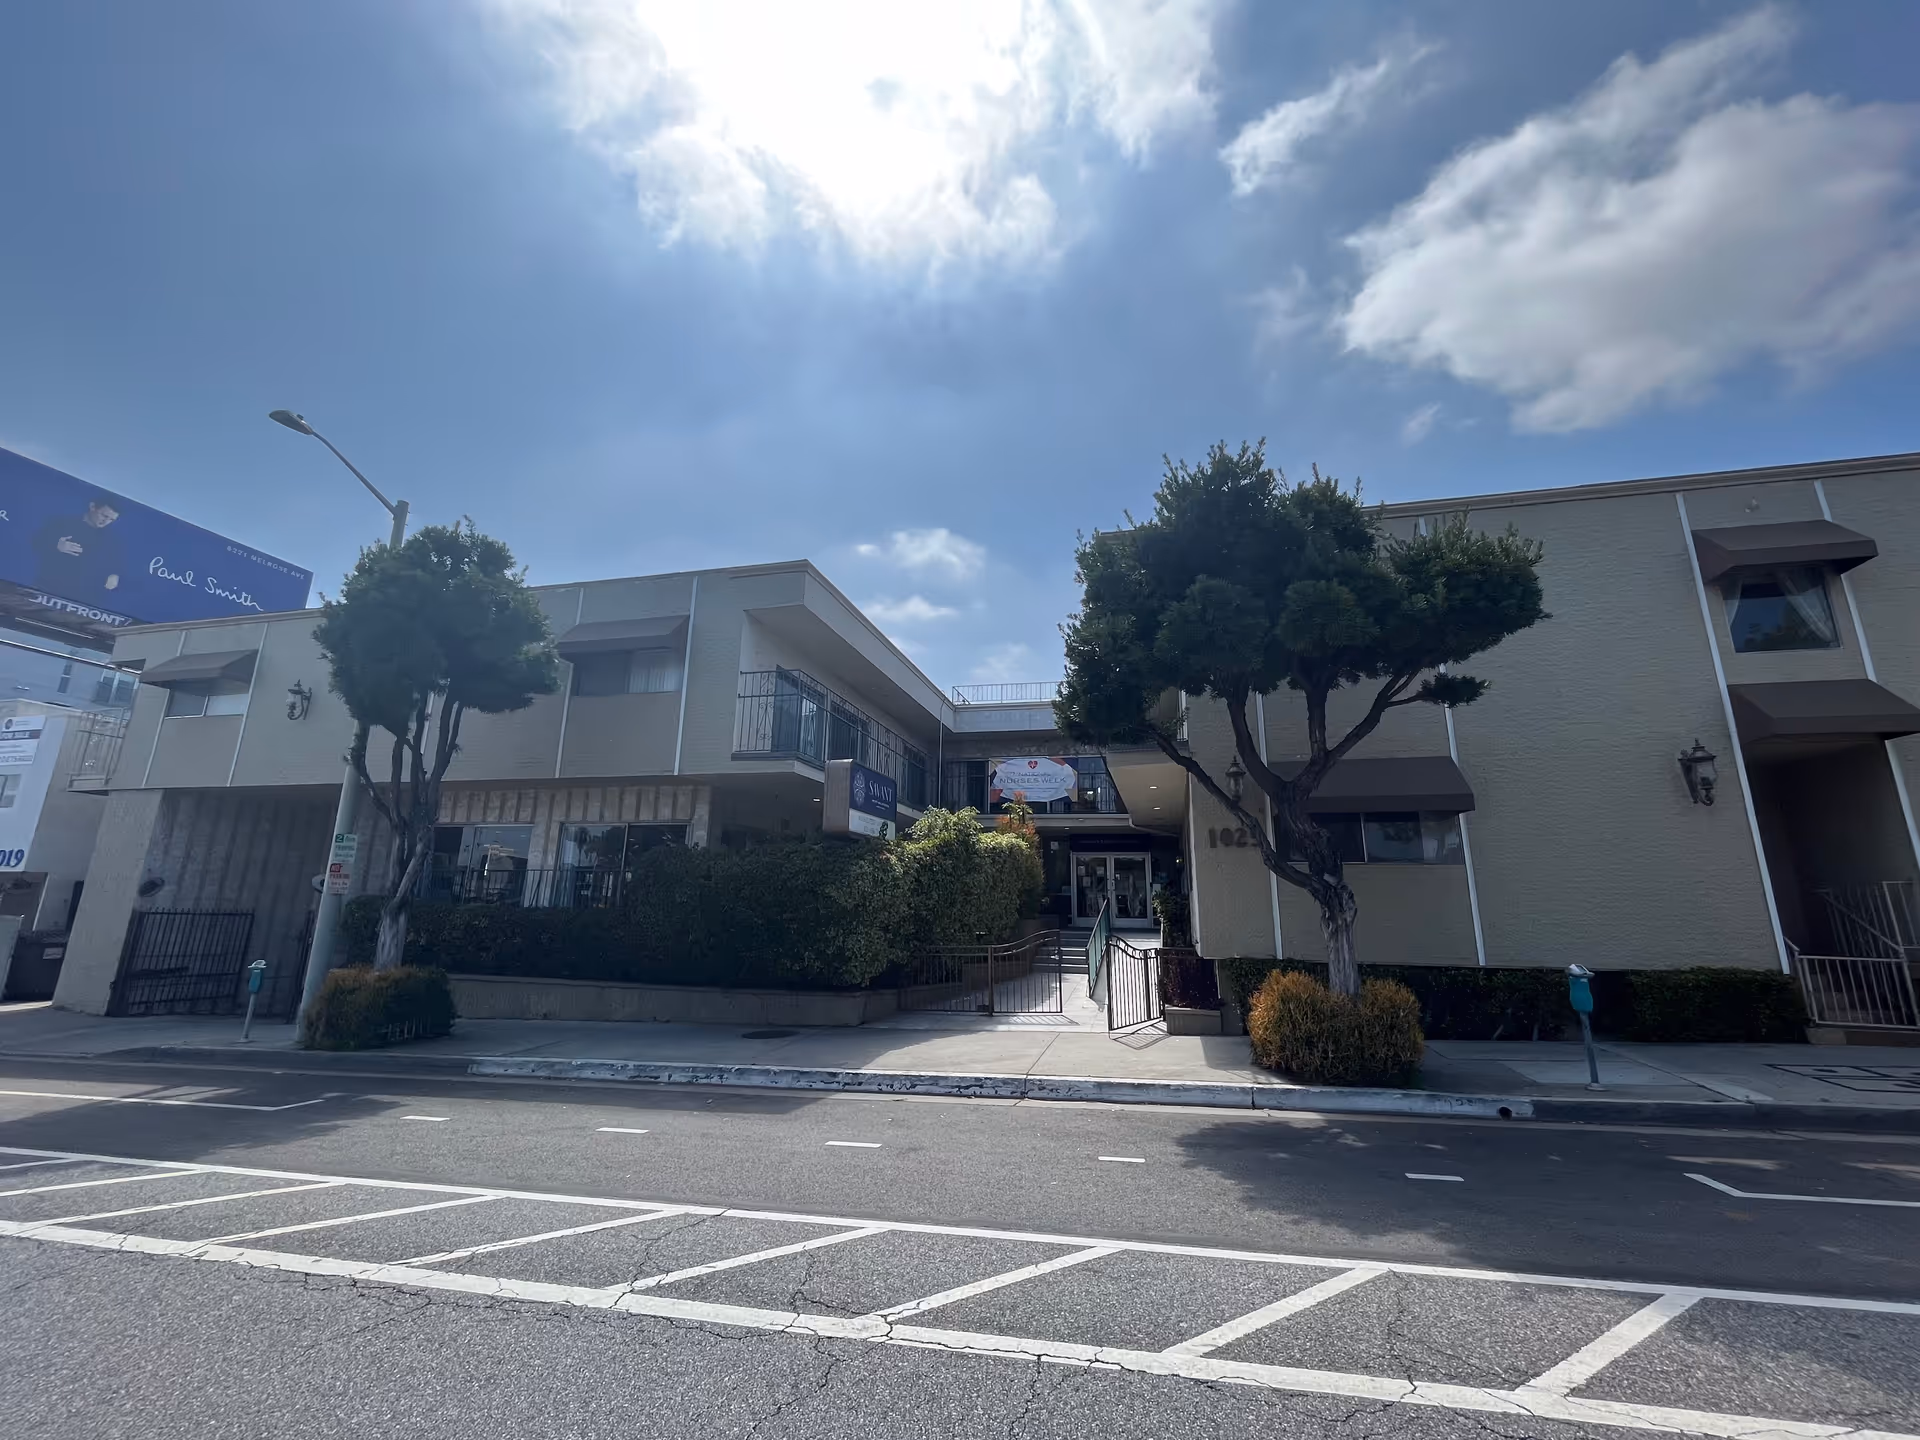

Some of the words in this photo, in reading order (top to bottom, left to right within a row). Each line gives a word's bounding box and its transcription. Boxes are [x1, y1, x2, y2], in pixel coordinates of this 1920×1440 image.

[251, 554, 288, 574] MELROSE
[149, 556, 196, 587] Paul
[205, 577, 264, 611] Smith
[1041, 776, 1067, 784] WEEK
